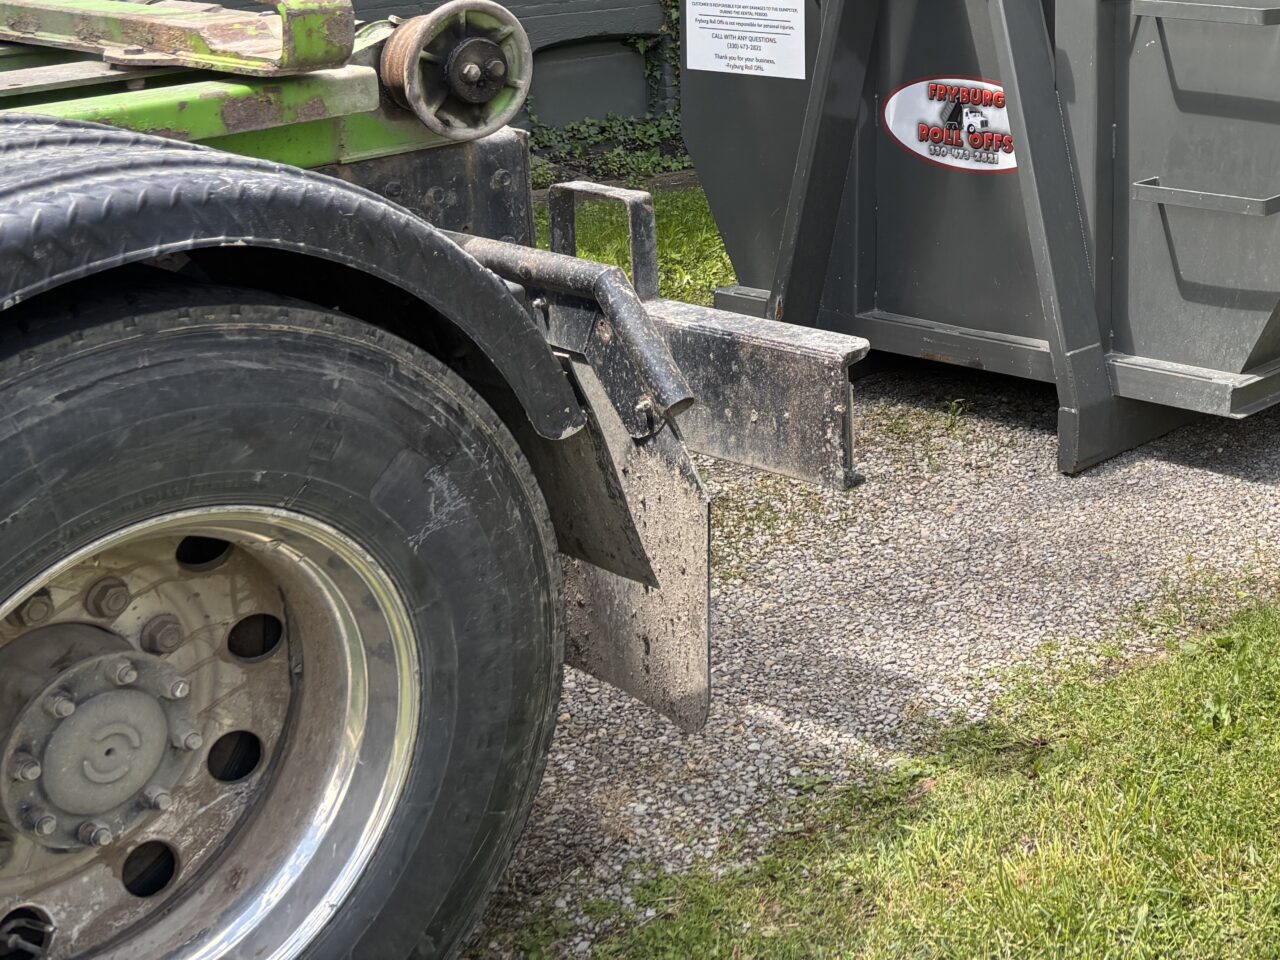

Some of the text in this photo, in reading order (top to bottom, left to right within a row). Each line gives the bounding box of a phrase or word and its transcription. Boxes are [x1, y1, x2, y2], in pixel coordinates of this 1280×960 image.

[711, 32, 723, 40] CALL
[724, 33, 737, 41] WITH
[928, 83, 1006, 109] FRYBURG
[917, 122, 1015, 155] ROLL OFFS
[928, 144, 1000, 165] 330-473-2821
